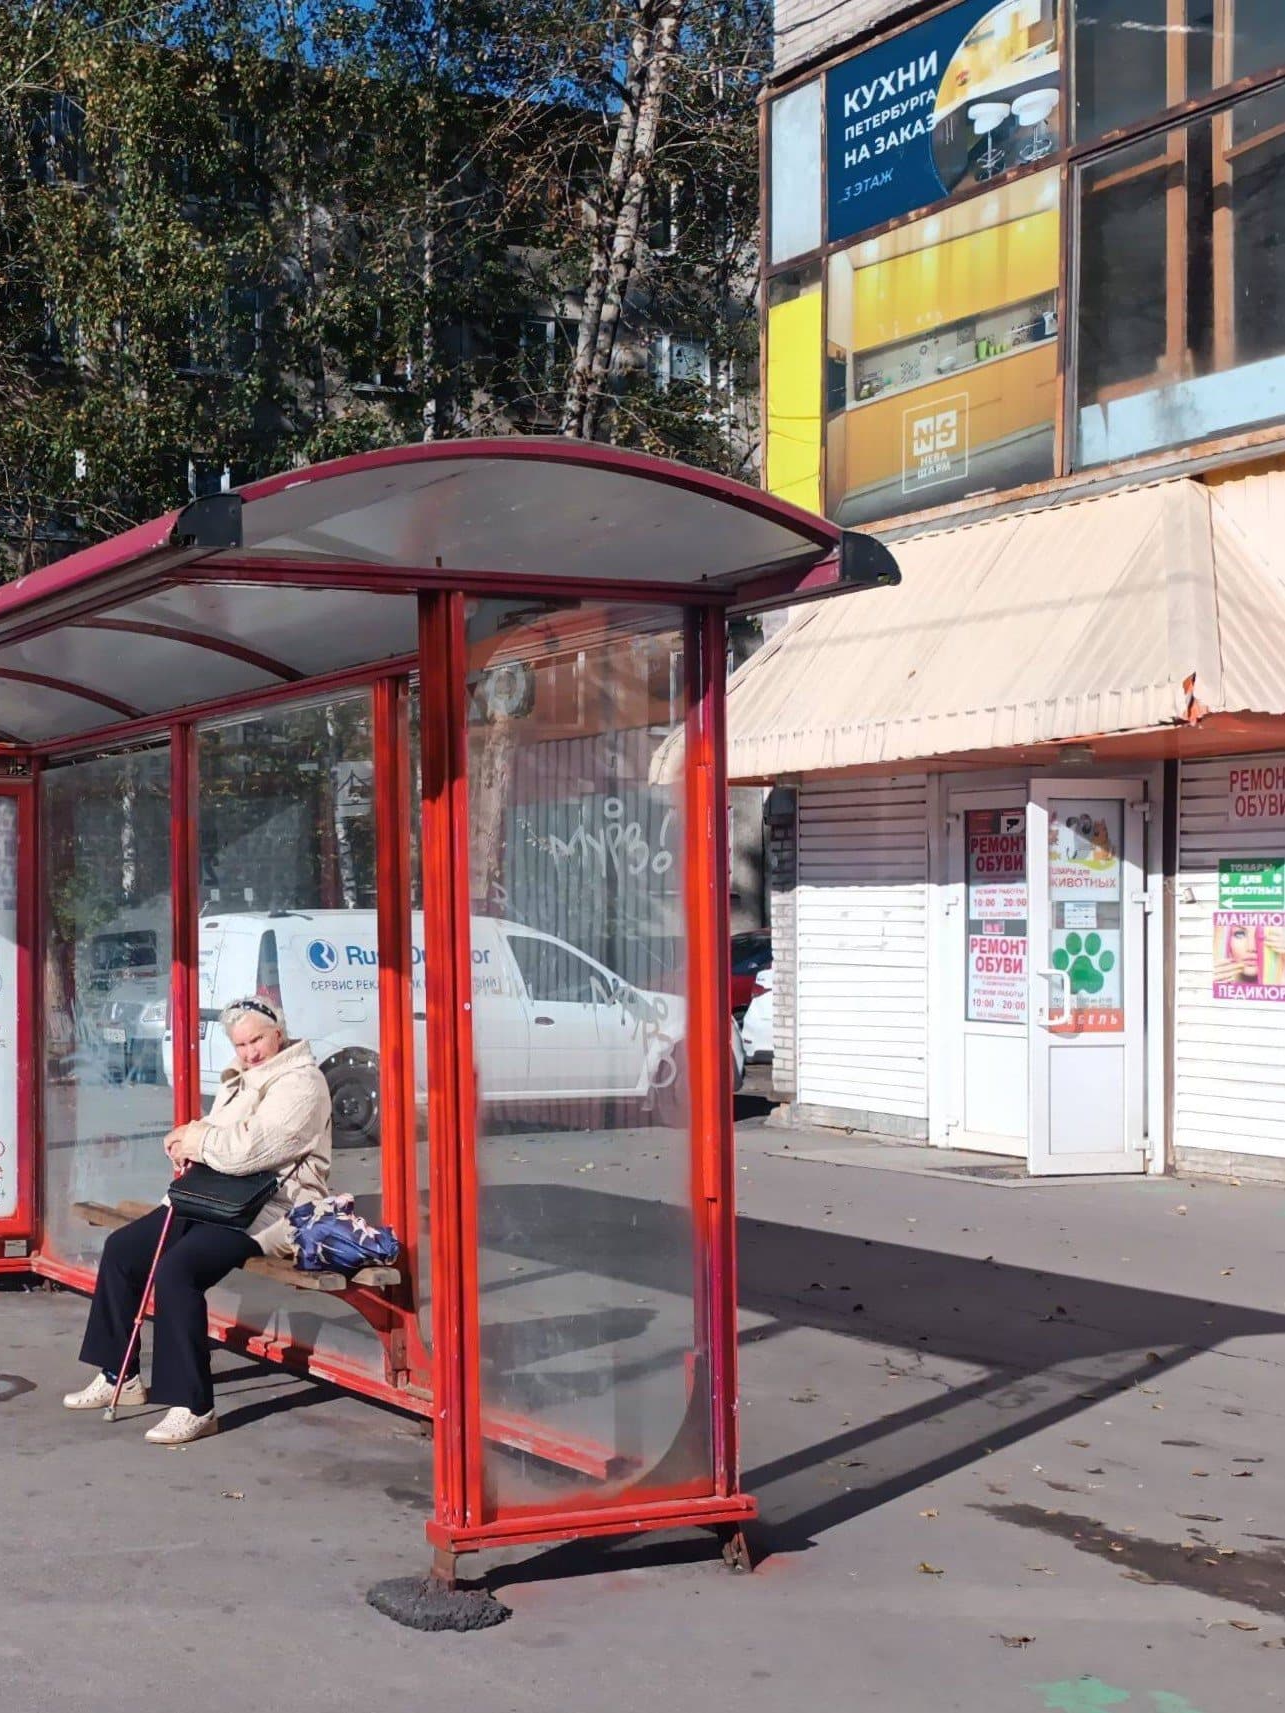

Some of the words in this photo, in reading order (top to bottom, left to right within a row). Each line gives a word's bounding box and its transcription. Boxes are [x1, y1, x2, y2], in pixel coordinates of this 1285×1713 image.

[844, 49, 938, 118] КУХНИ
[845, 88, 937, 141] ПЕТЕРБУРГА
[844, 144, 871, 169] НА
[874, 112, 938, 155] ЗАКАЗ
[839, 186, 852, 202] 3
[853, 168, 894, 196] ЭТАЖ
[970, 836, 1026, 854] РЕМОНТ
[976, 855, 1023, 872] ОБУВИ
[1217, 912, 1285, 927] МАНИКЮ
[970, 938, 1027, 956] РЕМОНТ
[975, 956, 1023, 974] ОБУВИ
[311, 979, 353, 990] СЕРВИС
[973, 998, 994, 1008] 10:00
[1002, 999, 1026, 1010] 20:00
